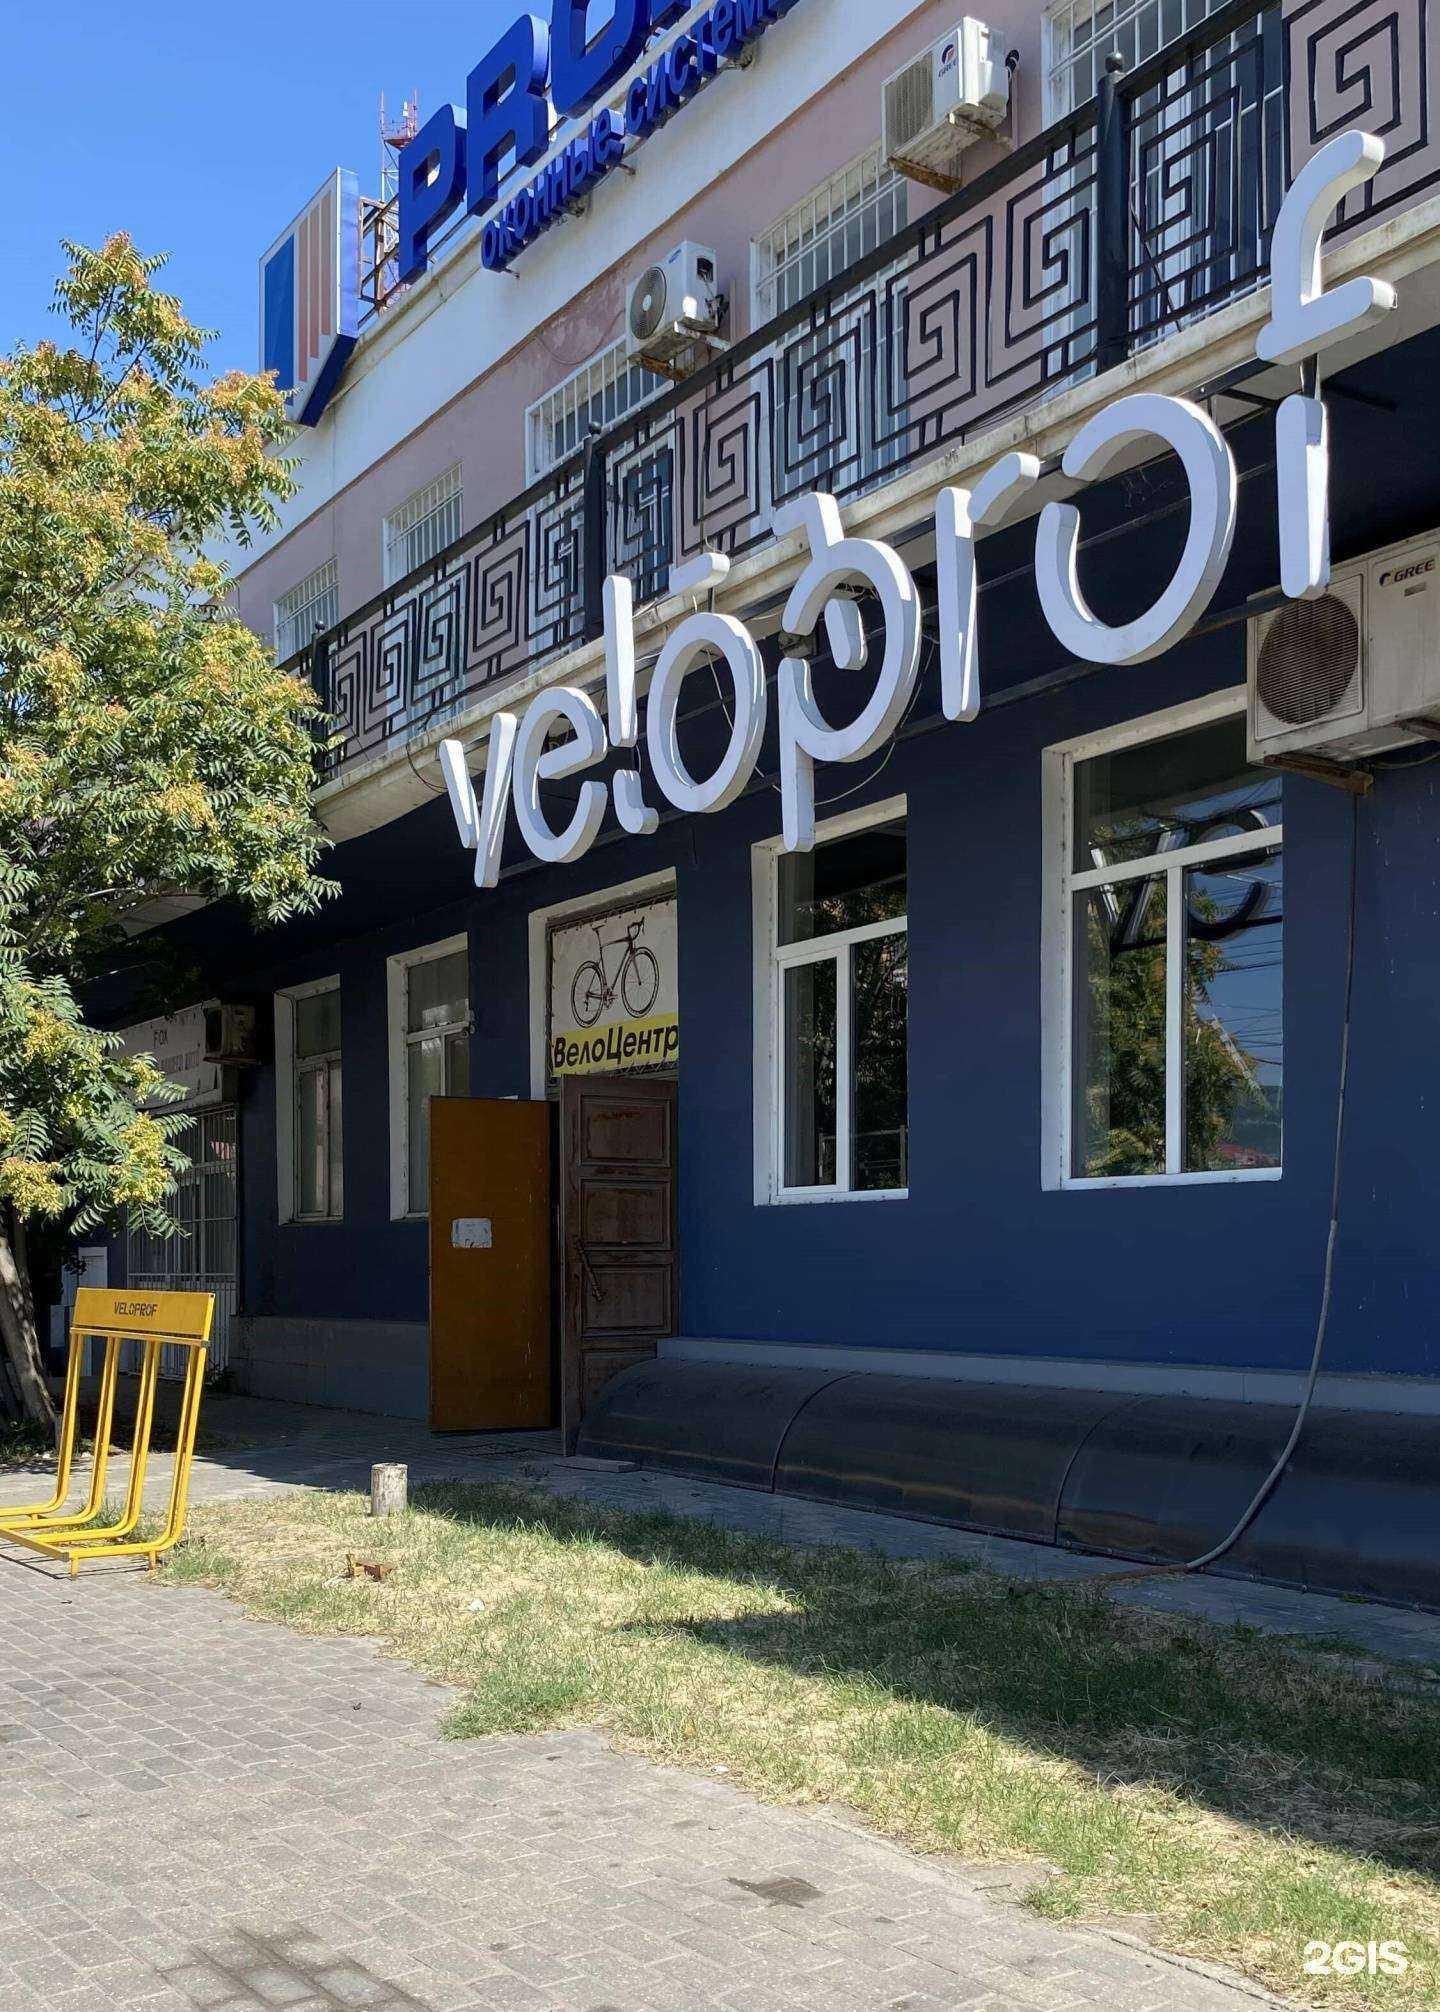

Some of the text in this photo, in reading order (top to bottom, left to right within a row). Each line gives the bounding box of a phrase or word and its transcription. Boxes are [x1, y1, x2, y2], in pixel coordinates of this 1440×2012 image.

[399, 0, 690, 283] PRO
[481, 0, 797, 271] оконные систем
[440, 130, 1397, 889] veloprof
[1394, 558, 1435, 583] GREE
[553, 1024, 678, 1068] ВелоЦентр
[114, 1301, 159, 1317] VELOPROF
